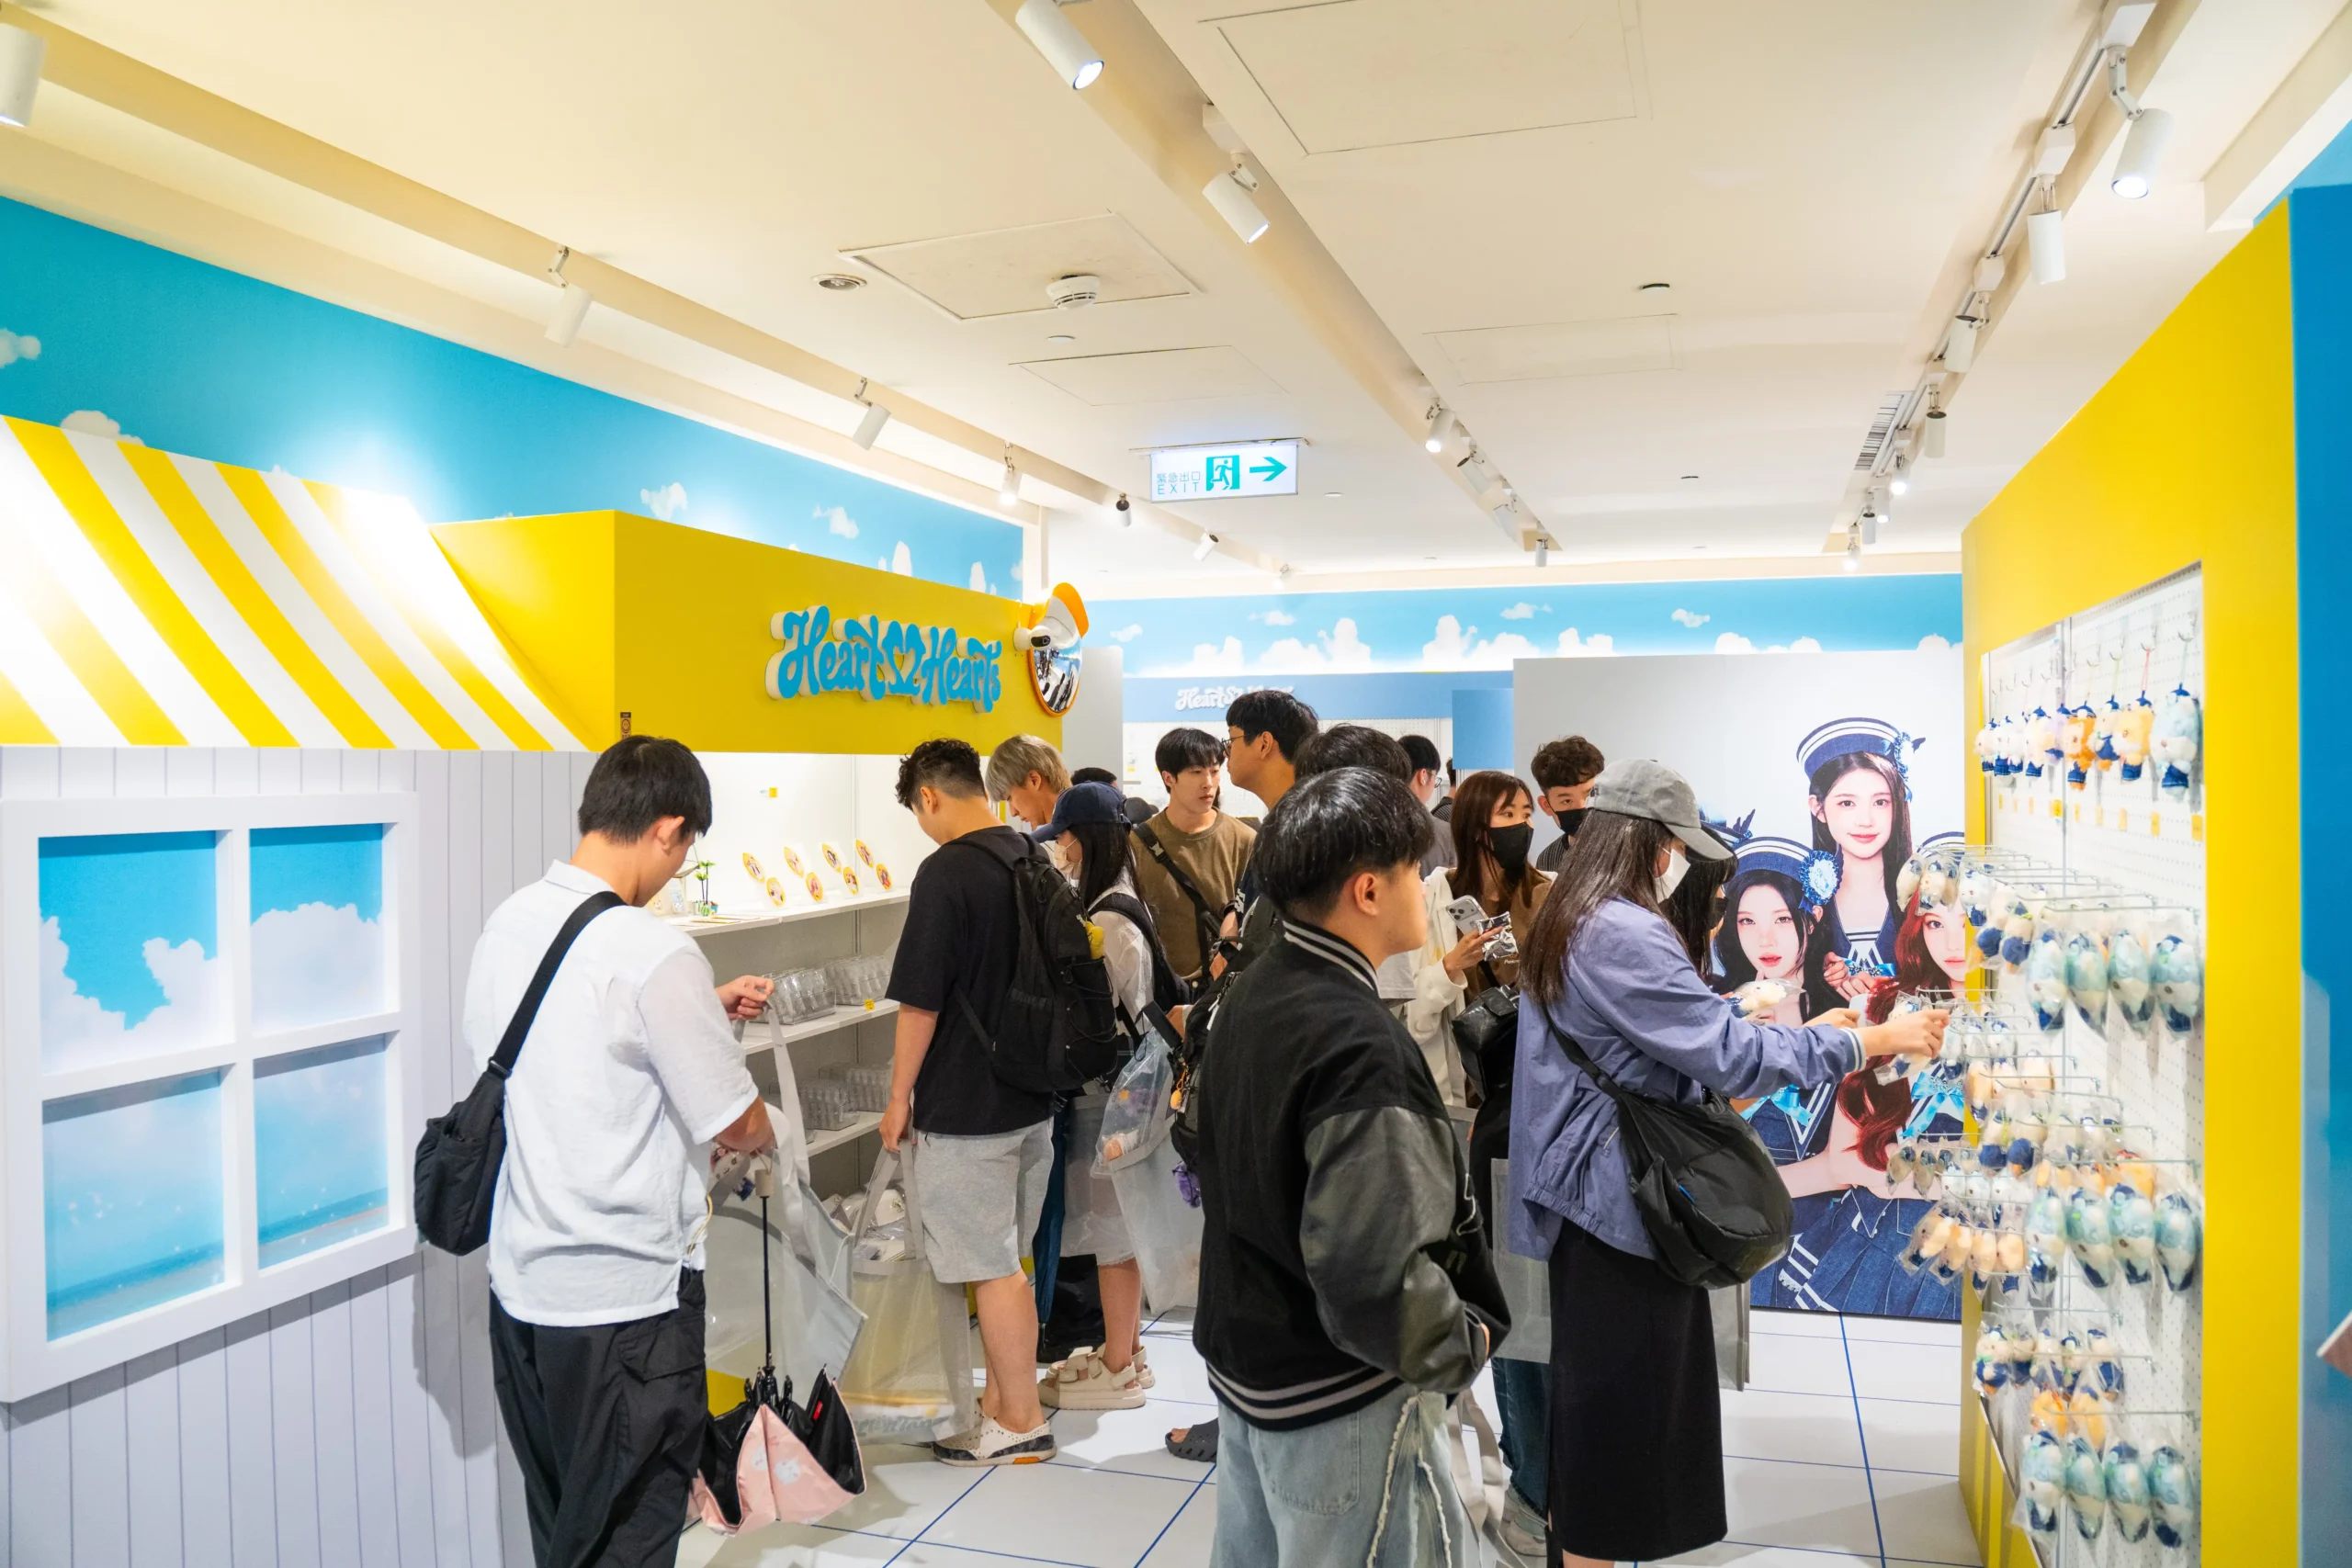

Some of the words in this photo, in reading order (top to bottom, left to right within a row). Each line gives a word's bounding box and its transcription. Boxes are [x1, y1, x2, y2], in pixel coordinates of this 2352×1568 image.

[1157, 470, 1201, 484] 緊急出口
[1158, 480, 1200, 495] EXIT
